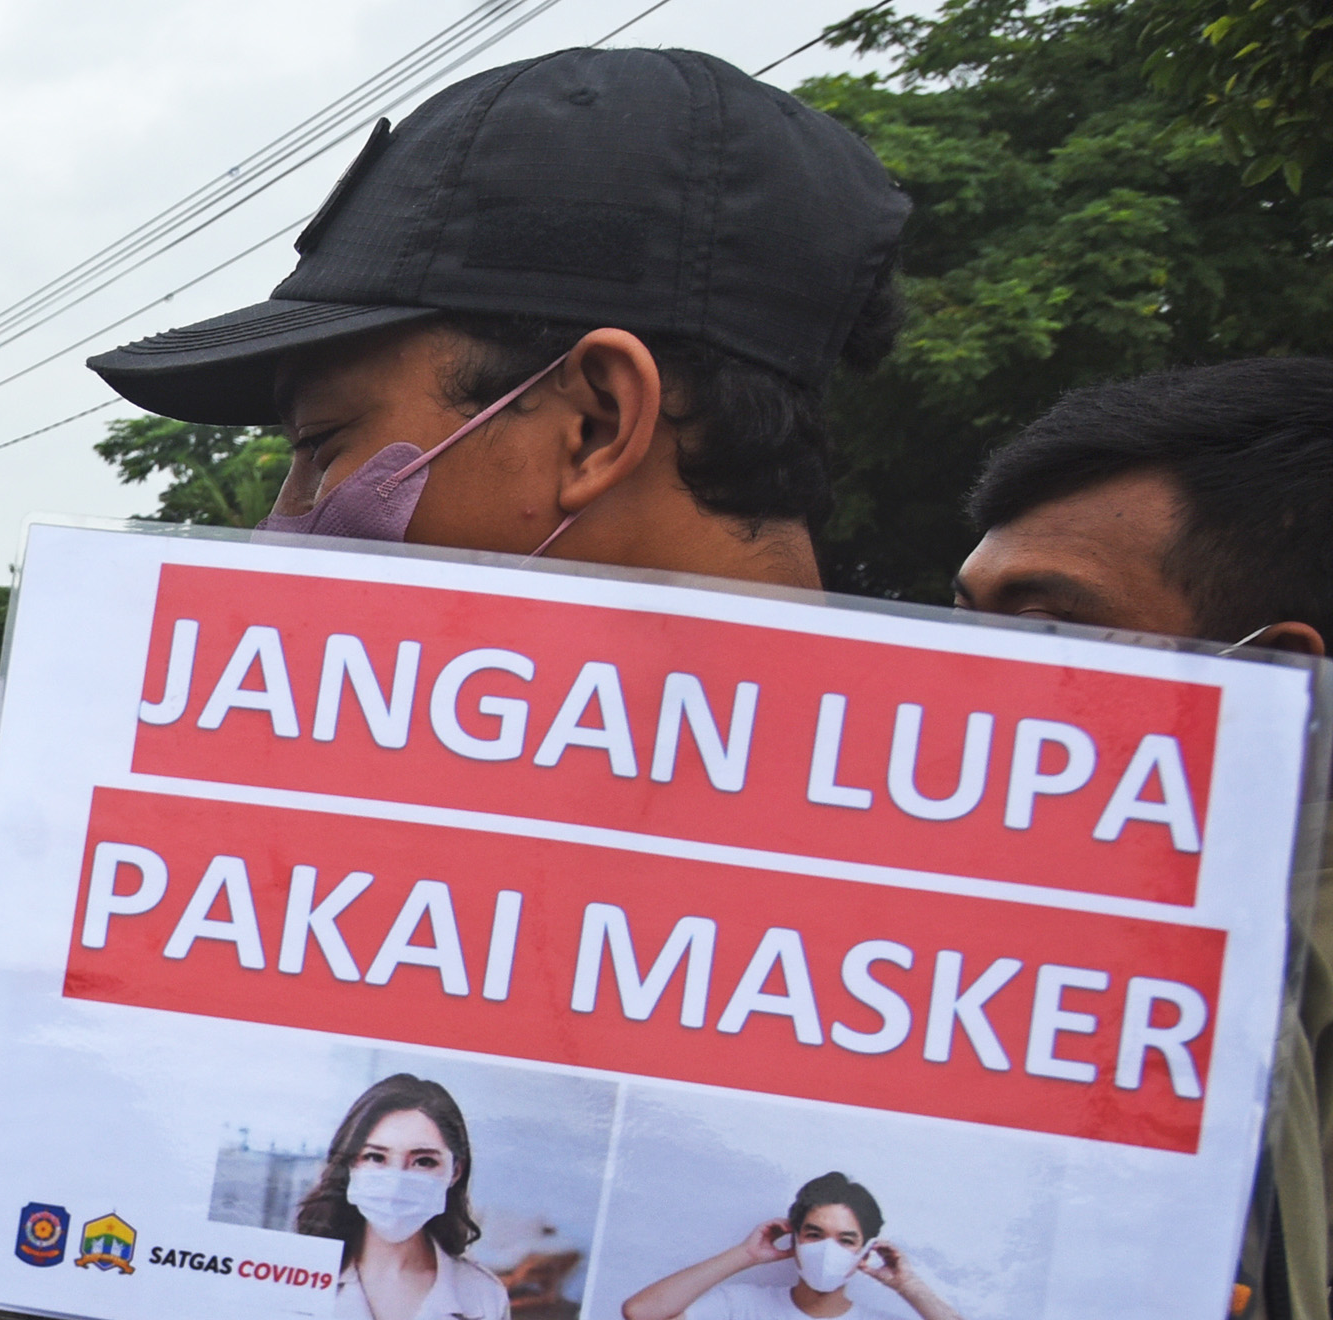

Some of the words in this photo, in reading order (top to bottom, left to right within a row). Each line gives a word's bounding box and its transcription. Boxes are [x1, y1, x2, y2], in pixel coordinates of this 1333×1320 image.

[137, 618, 760, 793] JANGAN
[805, 692, 1203, 853] LUPA
[80, 840, 523, 1001] PAKAI
[569, 901, 1210, 1099] MASKER
[148, 1246, 234, 1275] SATGAS
[237, 1259, 333, 1290] COVID19
